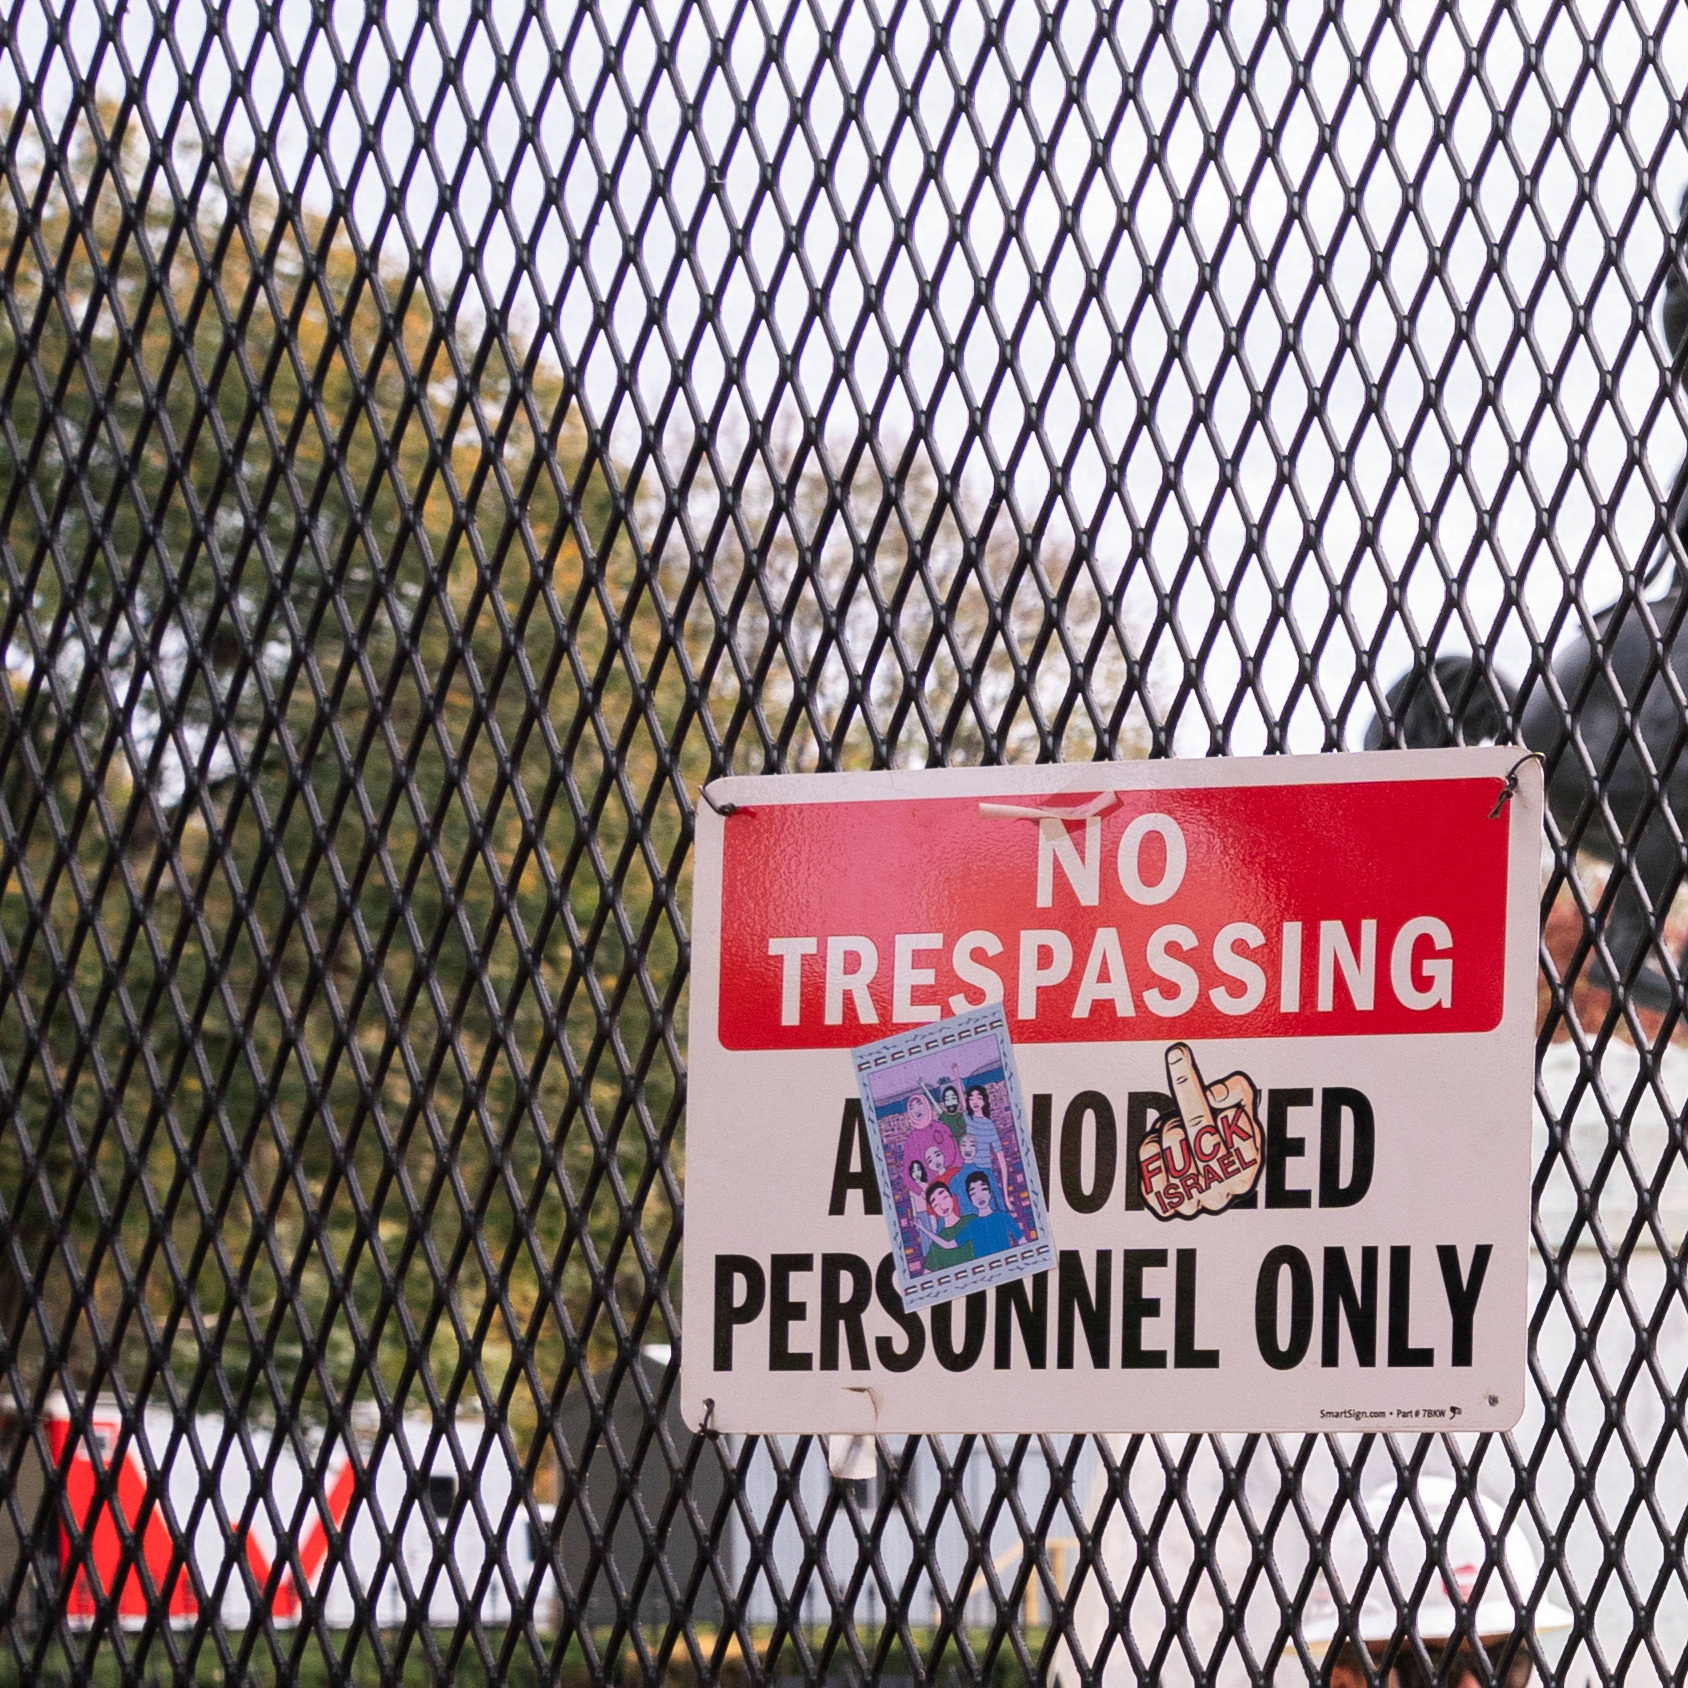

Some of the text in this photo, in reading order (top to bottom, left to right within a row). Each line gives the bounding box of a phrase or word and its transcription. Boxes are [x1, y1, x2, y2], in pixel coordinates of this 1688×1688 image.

[1036, 813, 1187, 908] NO
[768, 916, 1453, 1026] TRESPASSING
[1140, 1107, 1254, 1195] FUCK
[1154, 1146, 1258, 1215] ISRAEL
[713, 1244, 1494, 1373] PERSONNEL ONLY
[1319, 1408, 1386, 1421] SmartSign.com
[1396, 1408, 1413, 1418] Part
